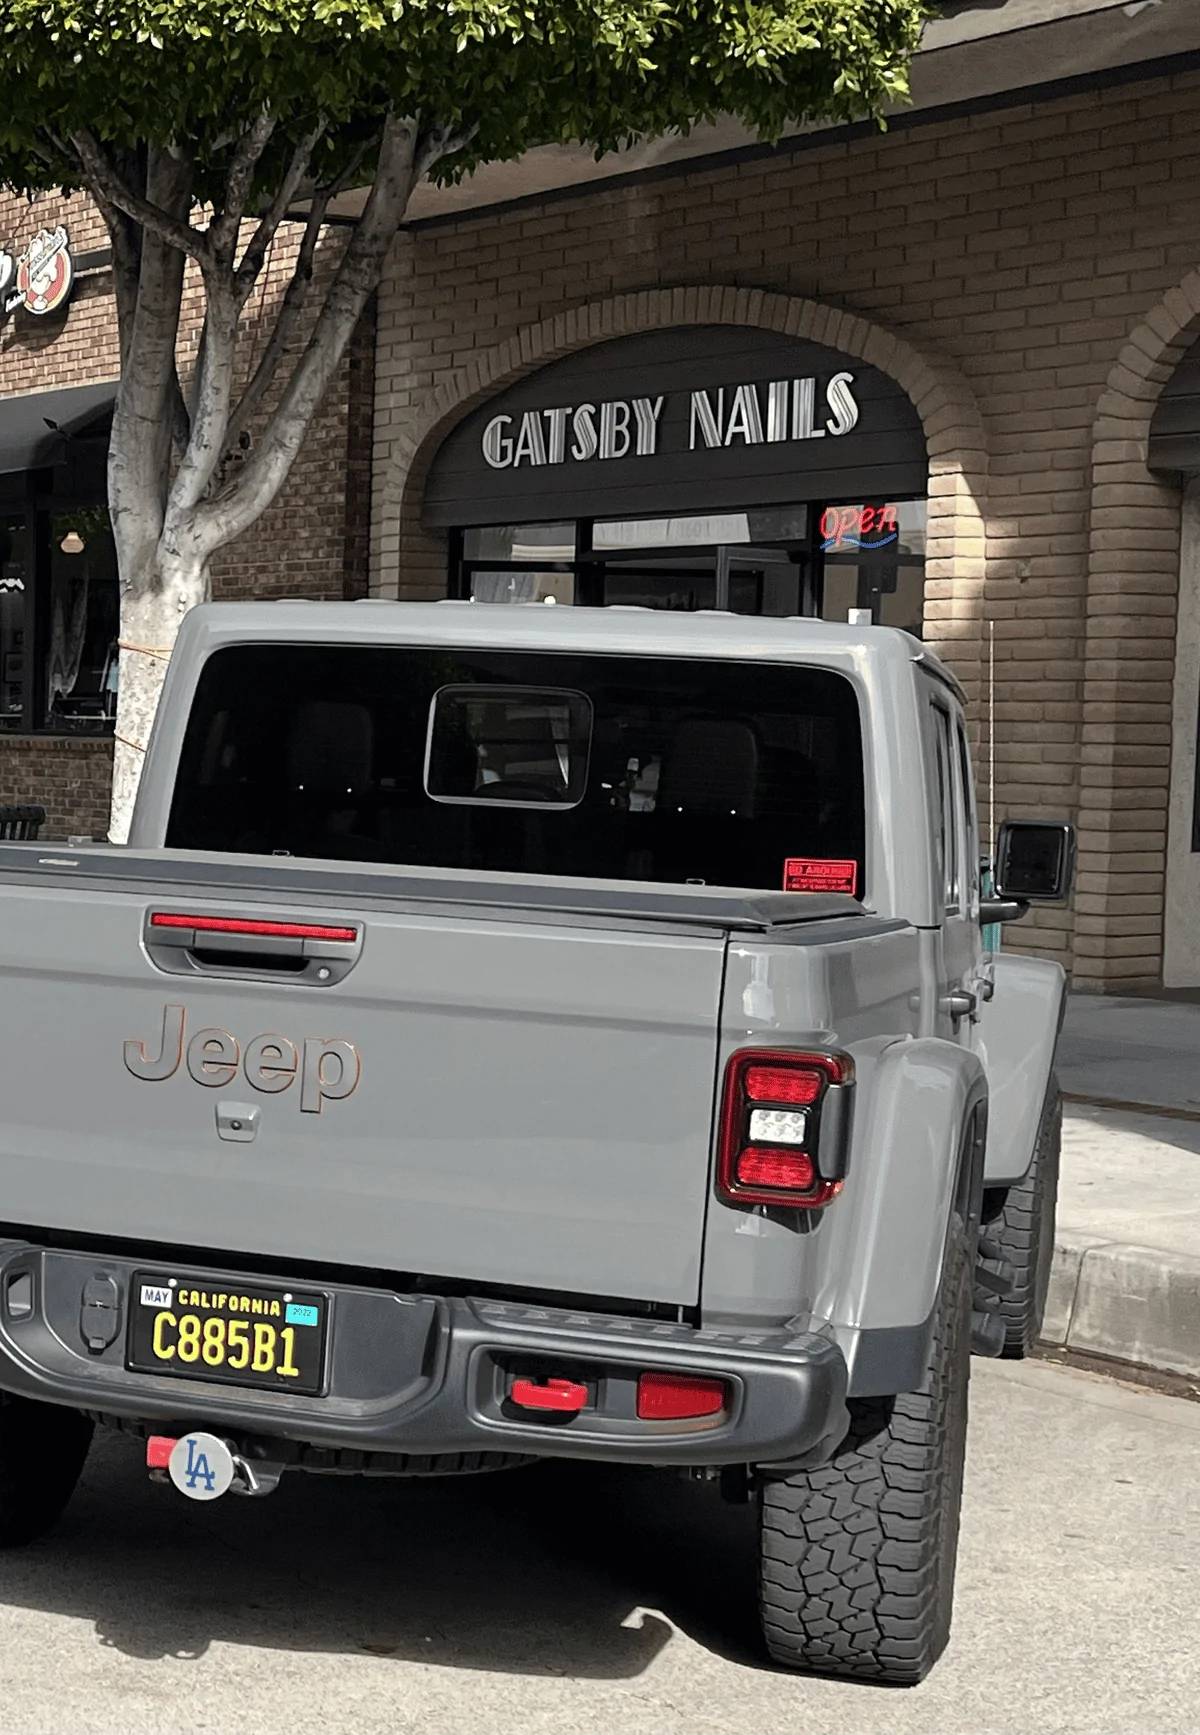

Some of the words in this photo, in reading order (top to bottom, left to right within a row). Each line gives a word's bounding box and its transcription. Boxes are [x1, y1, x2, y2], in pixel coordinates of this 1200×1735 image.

[482, 395, 665, 469] GATSBY
[689, 371, 860, 451] NAILS
[123, 1004, 362, 1115] Jeep
[144, 1288, 169, 1304] MAY
[178, 1289, 282, 1317] CALIFORNIA
[152, 1310, 300, 1377] C885B1
[184, 1438, 216, 1491] LA
